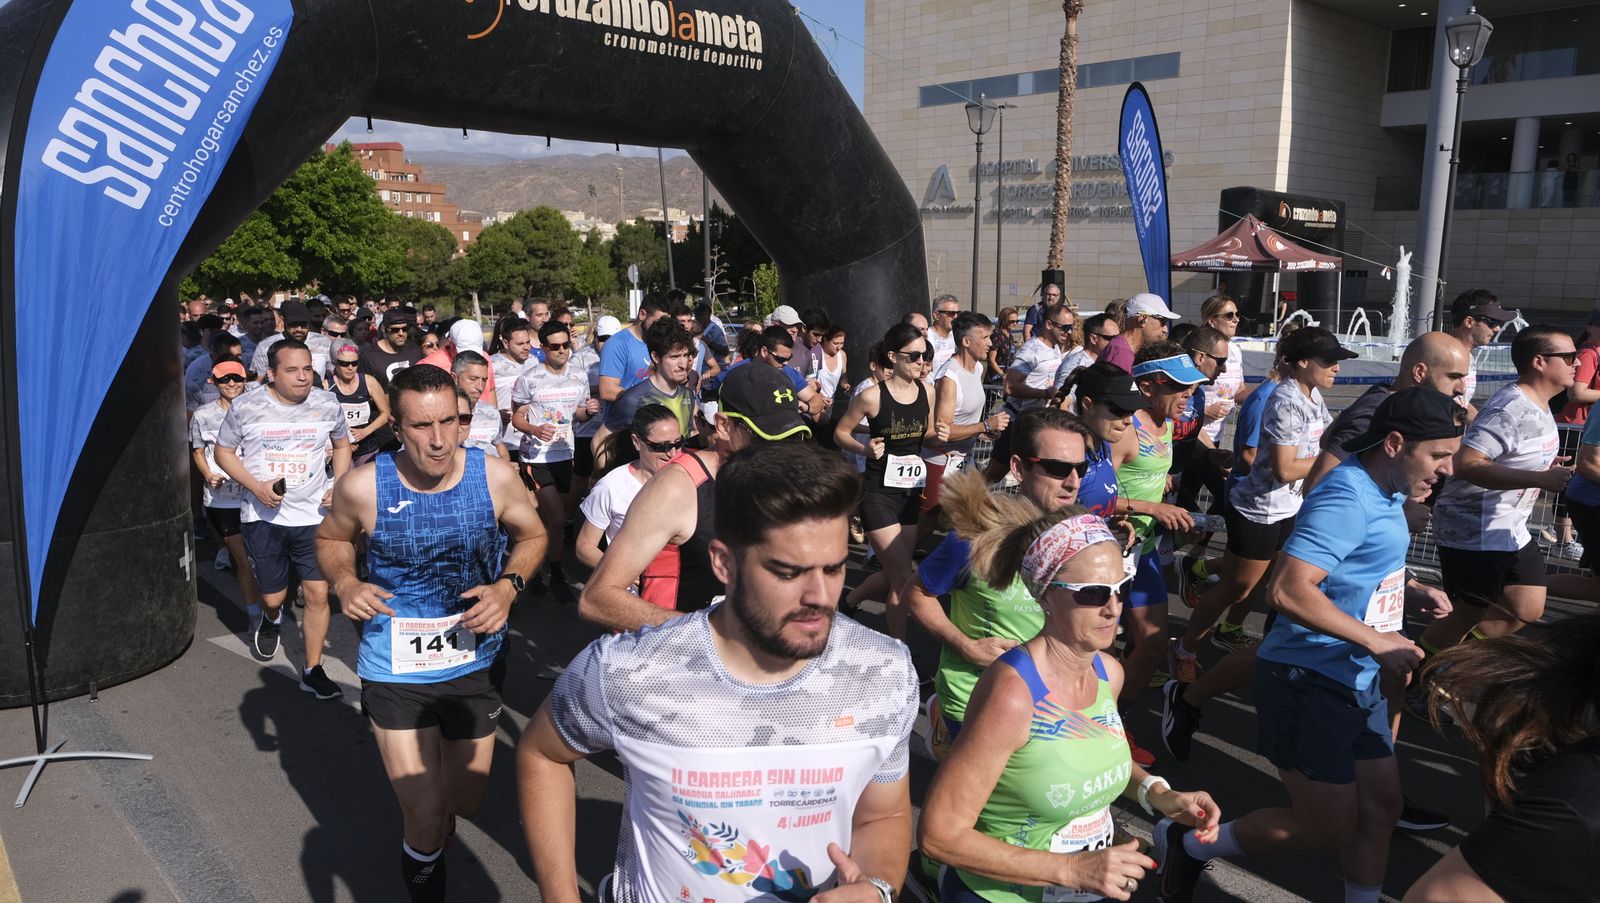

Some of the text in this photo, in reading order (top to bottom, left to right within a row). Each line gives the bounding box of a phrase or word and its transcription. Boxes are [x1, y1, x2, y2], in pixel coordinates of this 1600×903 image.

[604, 31, 763, 71] cronometraje deportivo
[158, 26, 284, 227] centrohogarsanchez.es
[346, 410, 361, 420] 51
[267, 462, 307, 474] 1139
[896, 465, 922, 477] 110
[1376, 590, 1403, 614] 126
[409, 631, 458, 654] 141
[672, 766, 844, 788] II CARRERA SIN HUMO
[685, 797, 719, 809] MUNDIAL
[769, 795, 838, 808] TORRECÁRDENAS
[776, 810, 832, 829] 4 JUNIO
